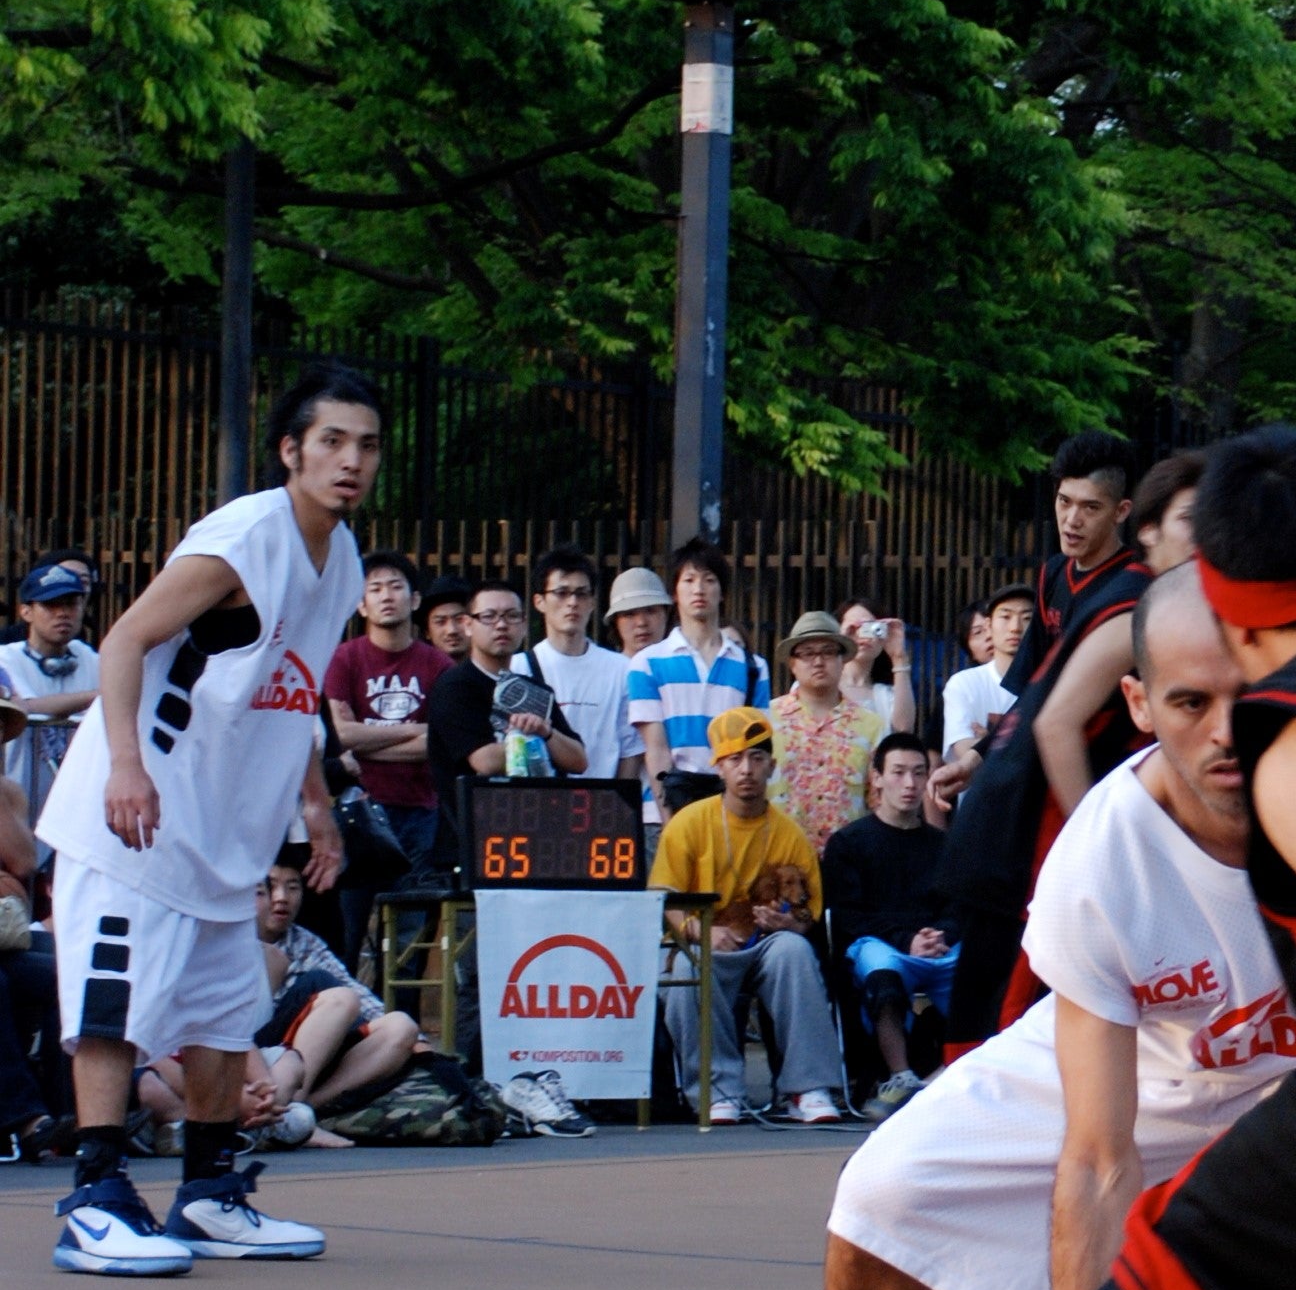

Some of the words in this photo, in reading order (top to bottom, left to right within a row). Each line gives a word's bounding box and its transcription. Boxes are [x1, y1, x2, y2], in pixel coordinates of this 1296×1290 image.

[484, 836, 530, 879] 65
[589, 837, 635, 879] 68
[500, 984, 645, 1019] ALLDAY
